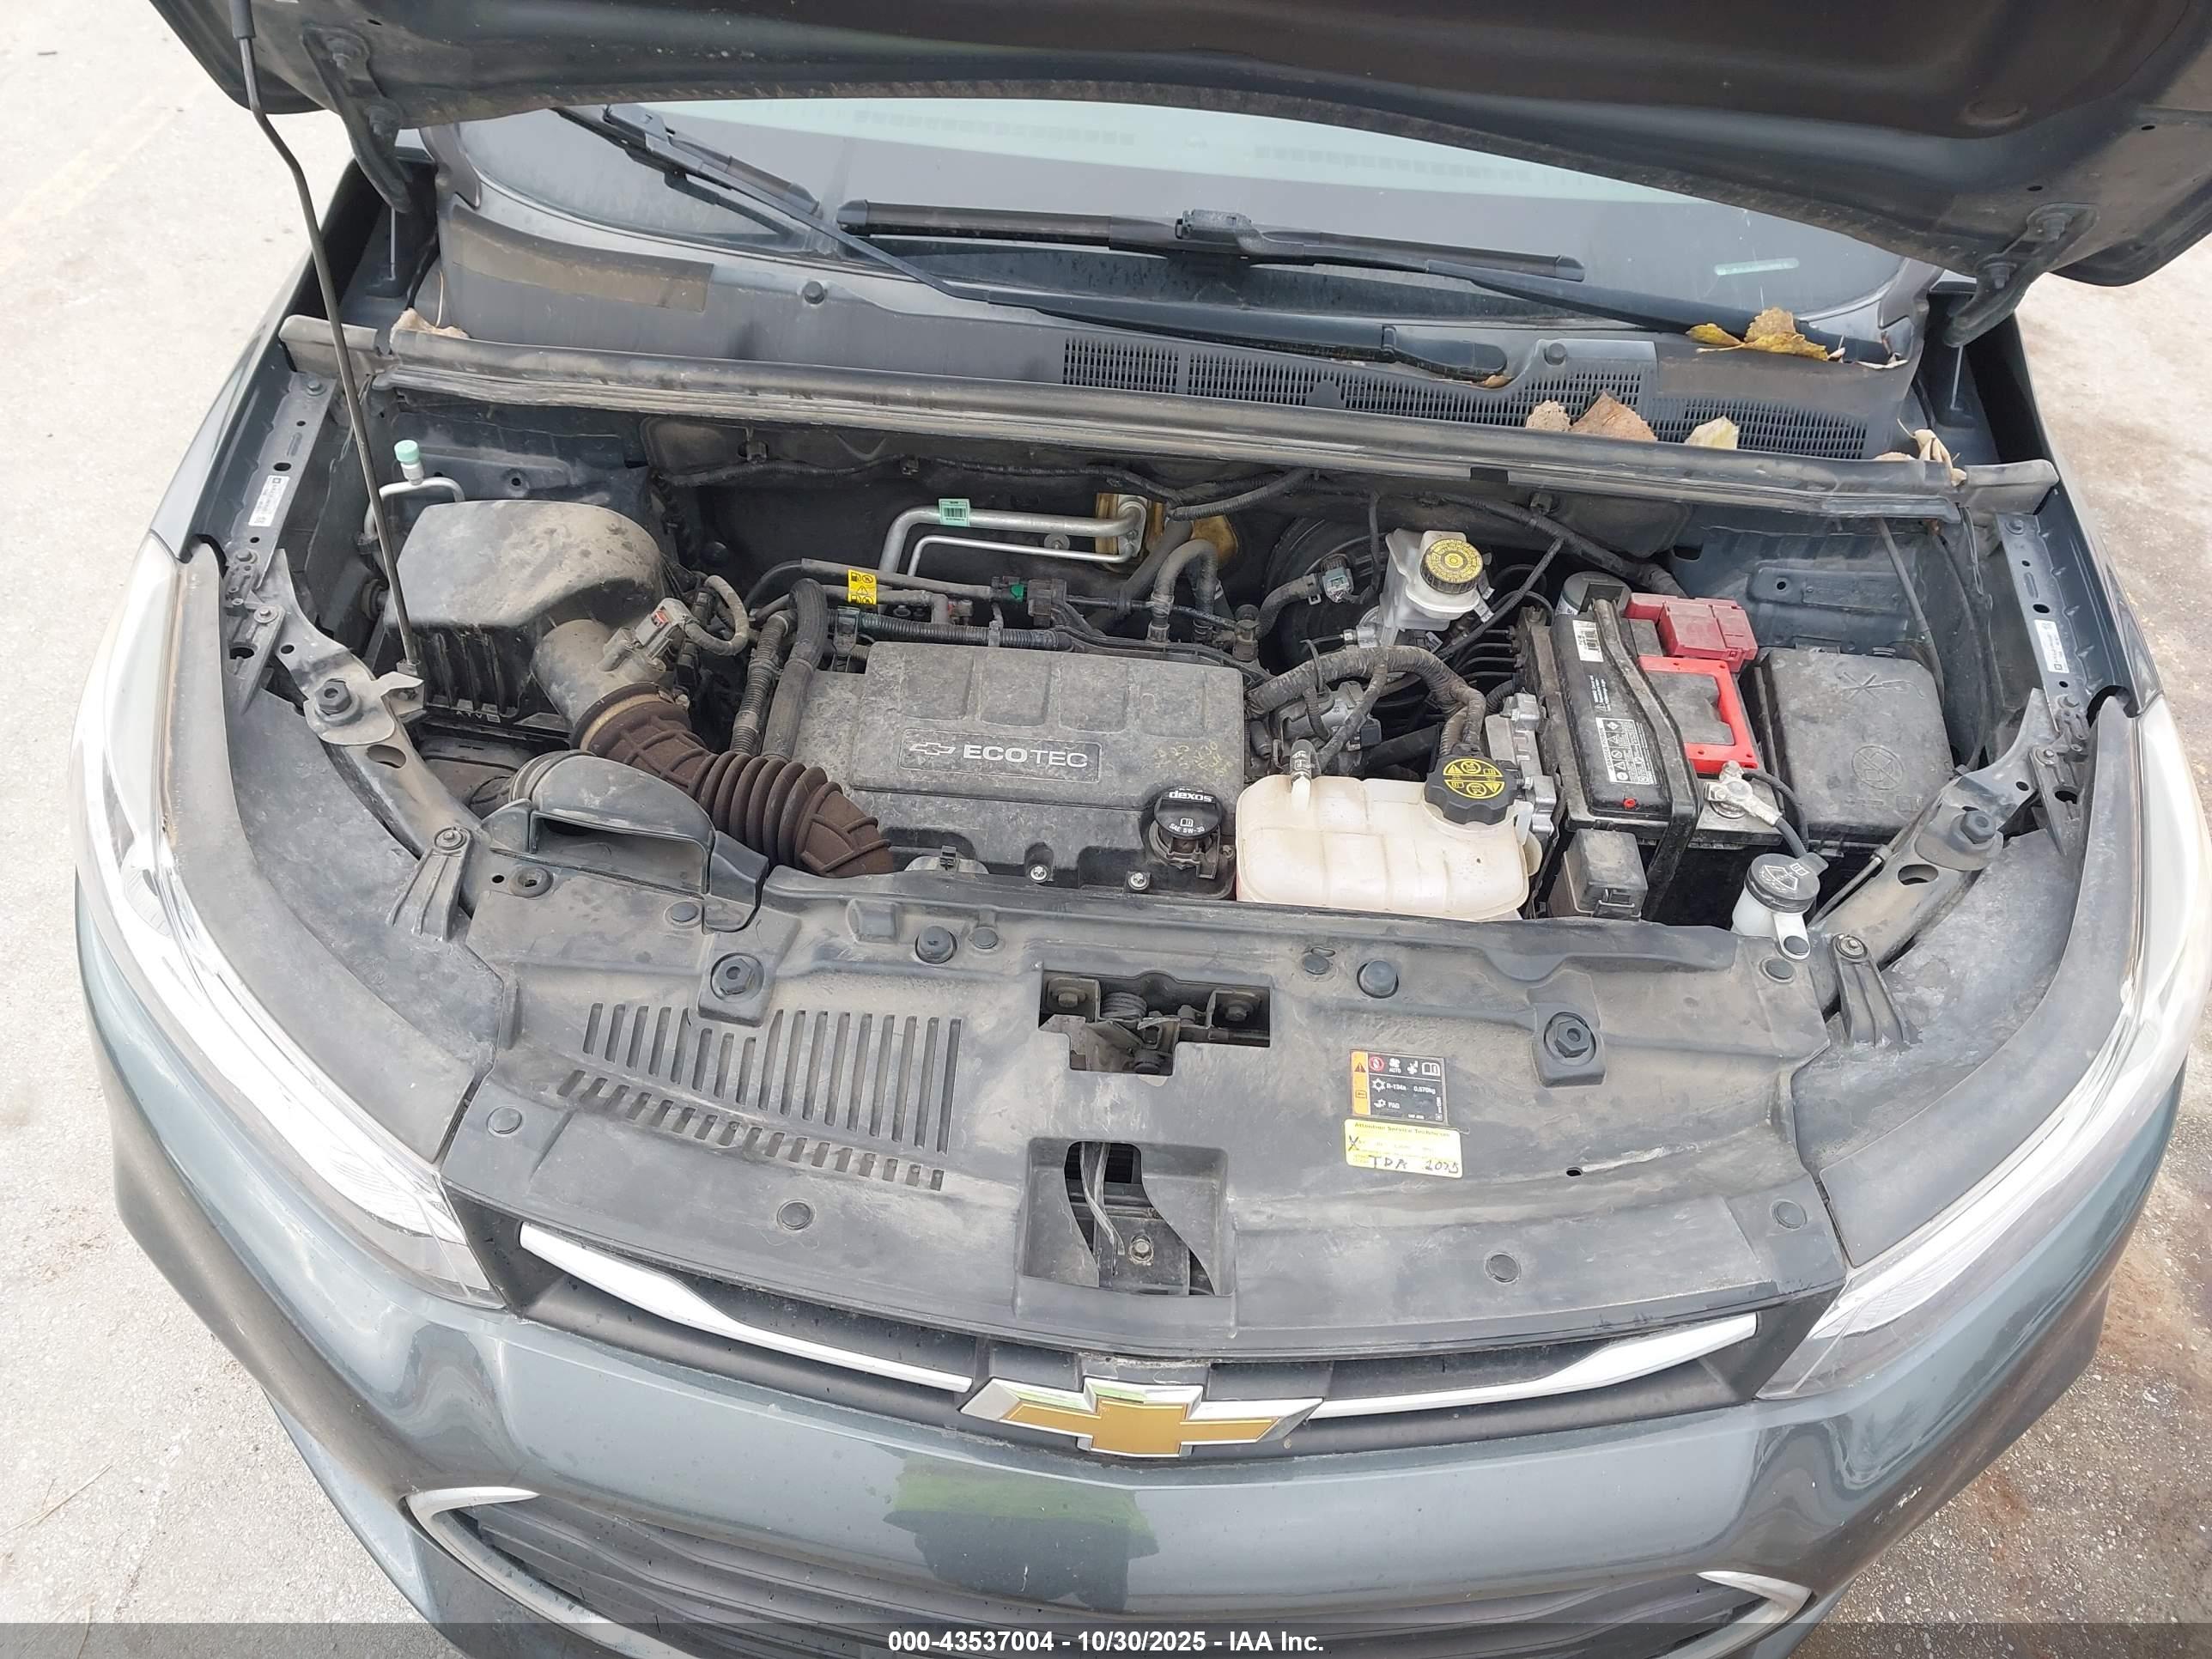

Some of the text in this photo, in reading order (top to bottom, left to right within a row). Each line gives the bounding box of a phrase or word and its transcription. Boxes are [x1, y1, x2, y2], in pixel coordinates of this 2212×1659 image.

[963, 744, 1088, 768] ECOTEC
[1168, 790, 1213, 803] dexos
[1169, 823, 1182, 833] SAE
